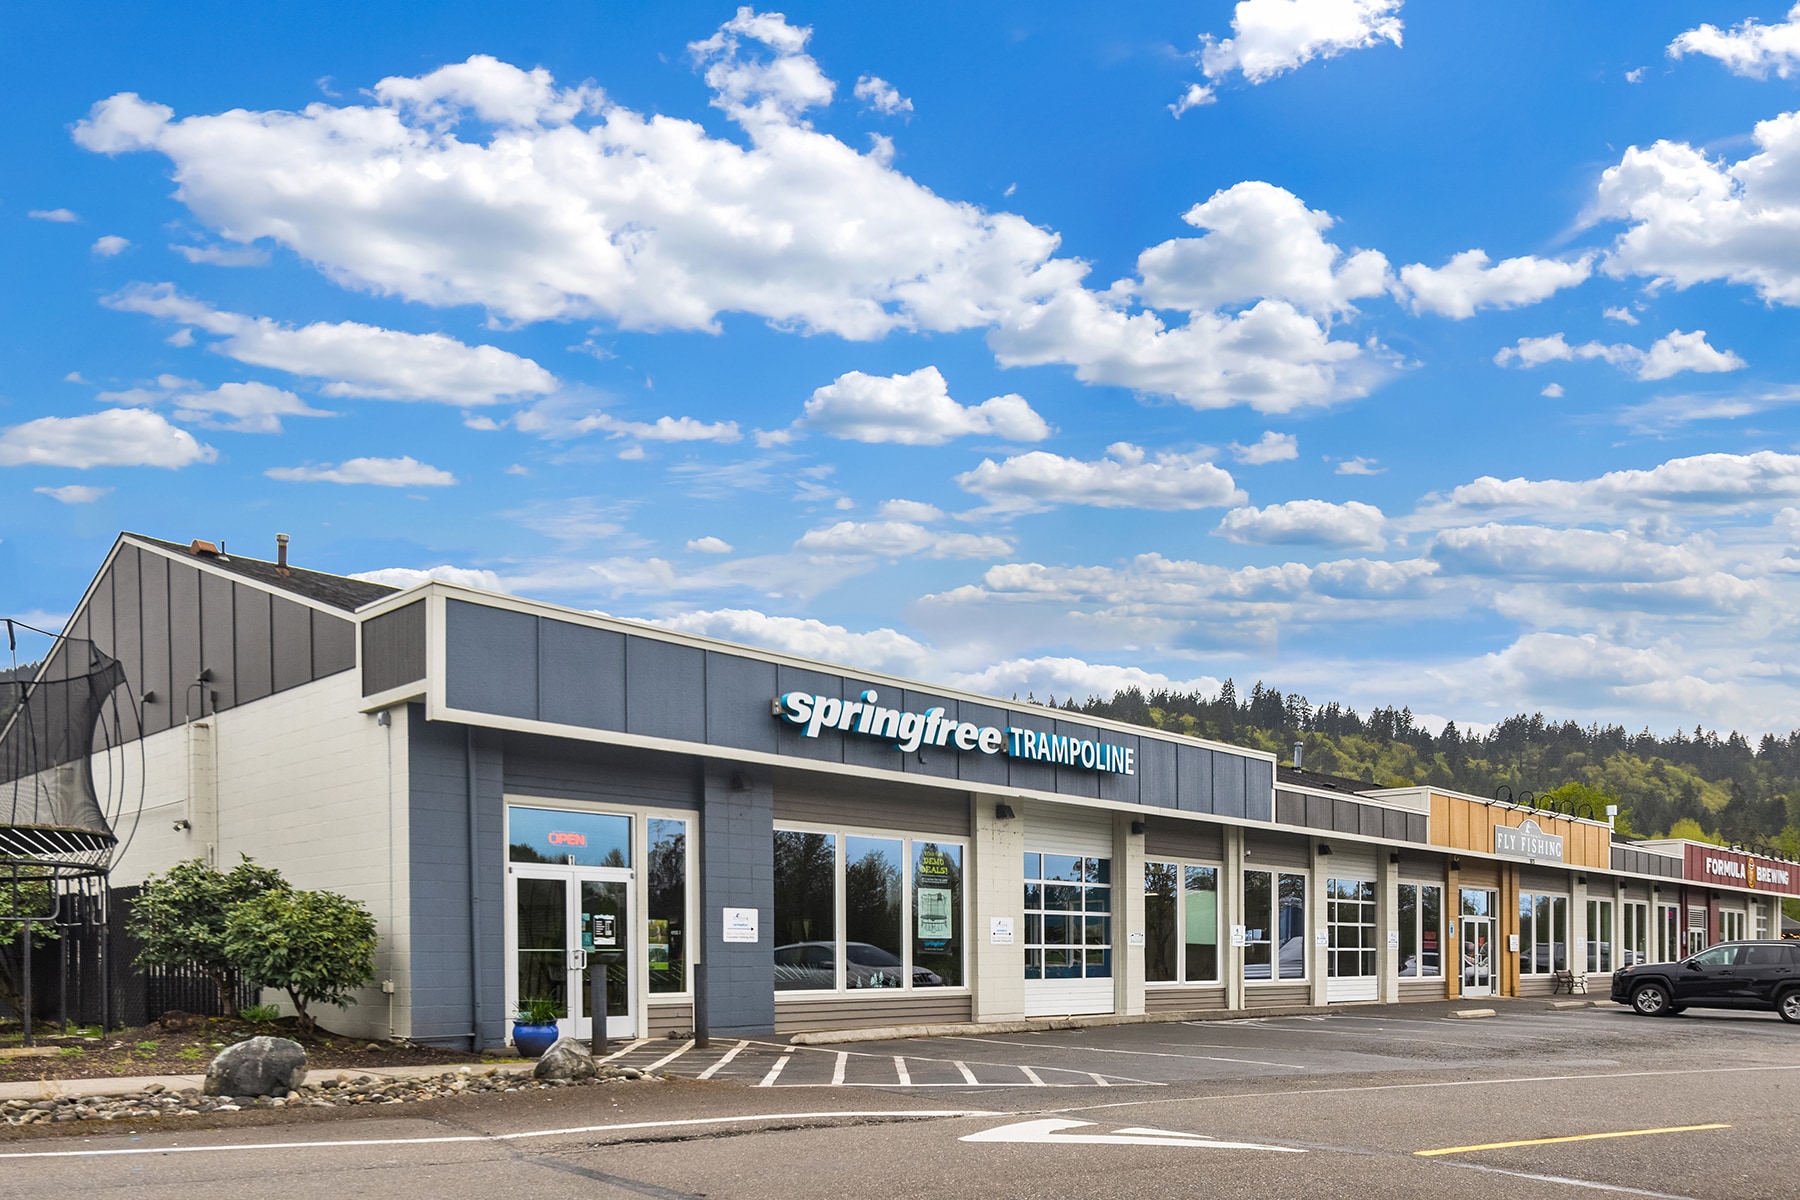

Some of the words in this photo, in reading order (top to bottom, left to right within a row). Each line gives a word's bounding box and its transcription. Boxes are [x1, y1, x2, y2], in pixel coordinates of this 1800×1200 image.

[780, 689, 1001, 754] springfree
[1007, 727, 1135, 775] TRAMPOLINE
[548, 831, 586, 847] OPEN
[1497, 832, 1516, 850] FLY
[1520, 836, 1562, 857] FISHING
[920, 865, 948, 875] DEALS!
[923, 857, 945, 866] DEMO
[1705, 857, 1746, 880] FORMULA
[1756, 866, 1790, 886] BREWING
